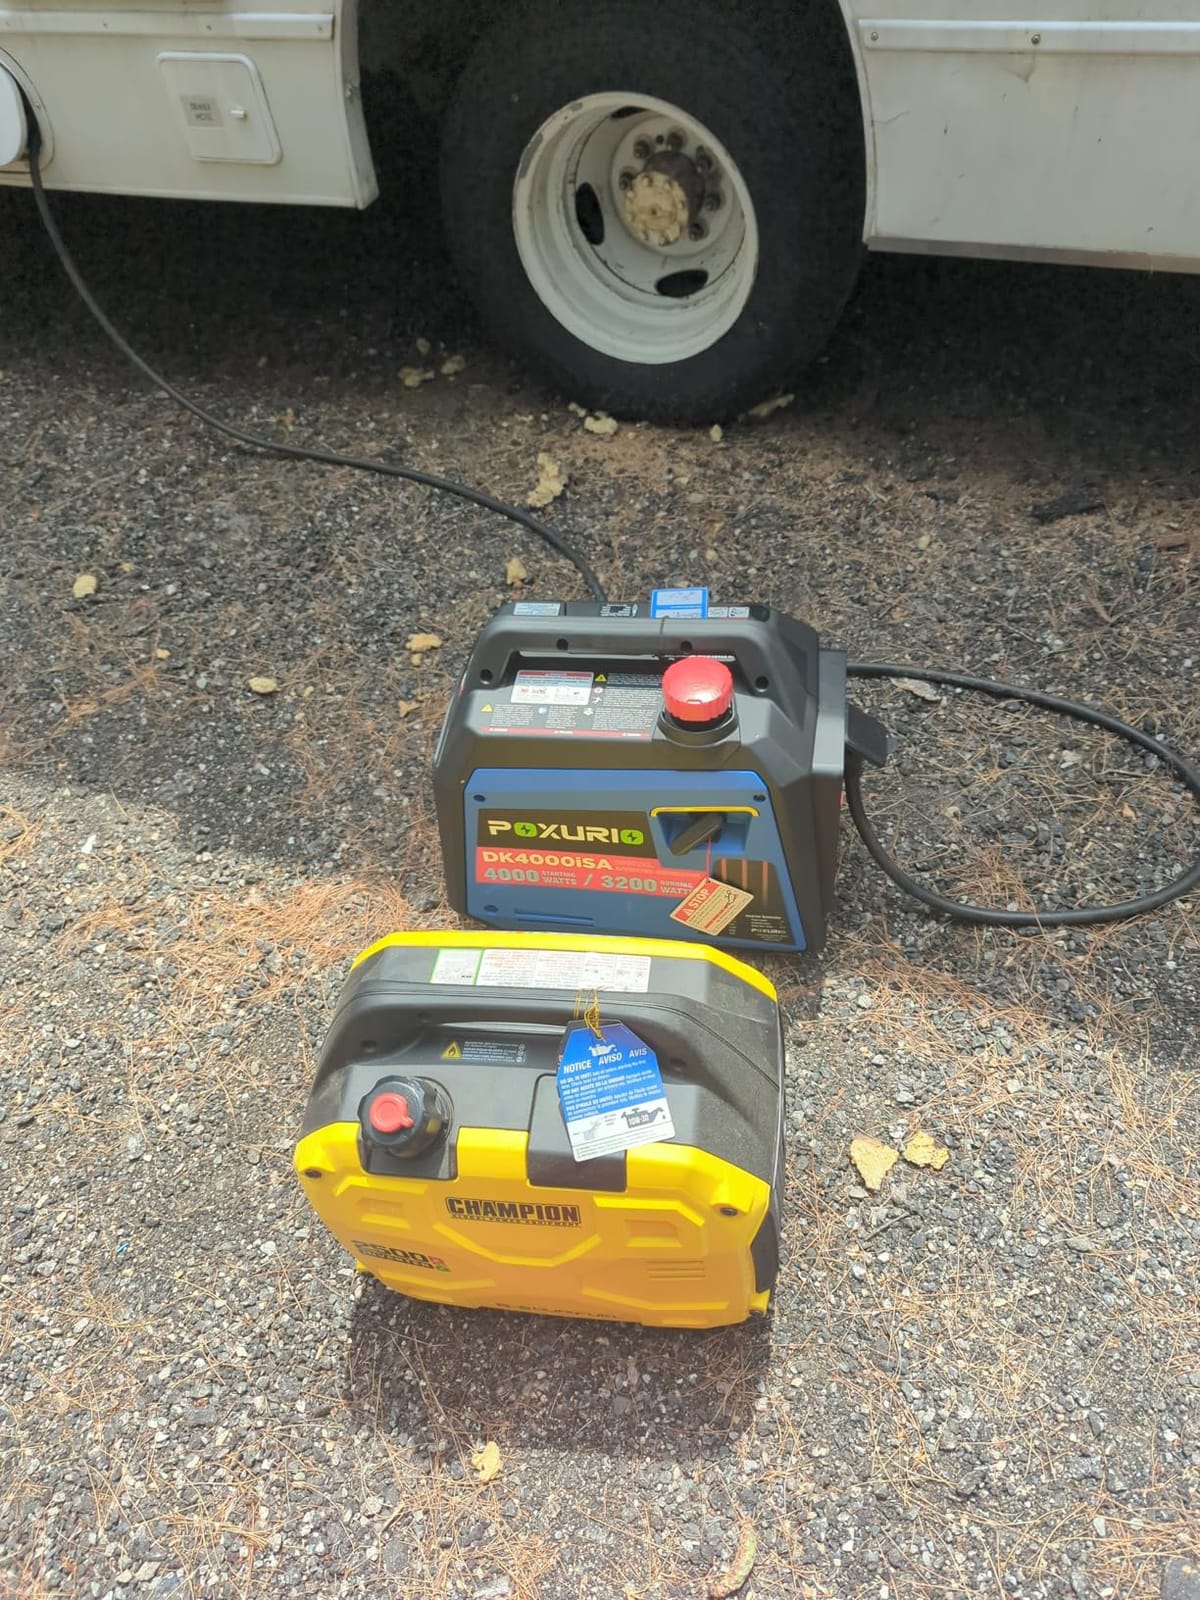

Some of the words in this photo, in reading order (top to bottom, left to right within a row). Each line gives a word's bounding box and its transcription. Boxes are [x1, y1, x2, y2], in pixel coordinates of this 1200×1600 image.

[487, 820, 644, 845] POXURIO
[482, 851, 613, 870] DK4000iSA
[484, 868, 540, 883] 4000
[542, 877, 577, 885] WATTS
[601, 875, 657, 892] 3200
[660, 886, 693, 895] WATT
[688, 888, 710, 911] STOP
[563, 1059, 592, 1074] NOTICE
[598, 1052, 622, 1065] AVISO
[629, 1048, 648, 1058] AVIS
[447, 1198, 578, 1222] CHAMPION
